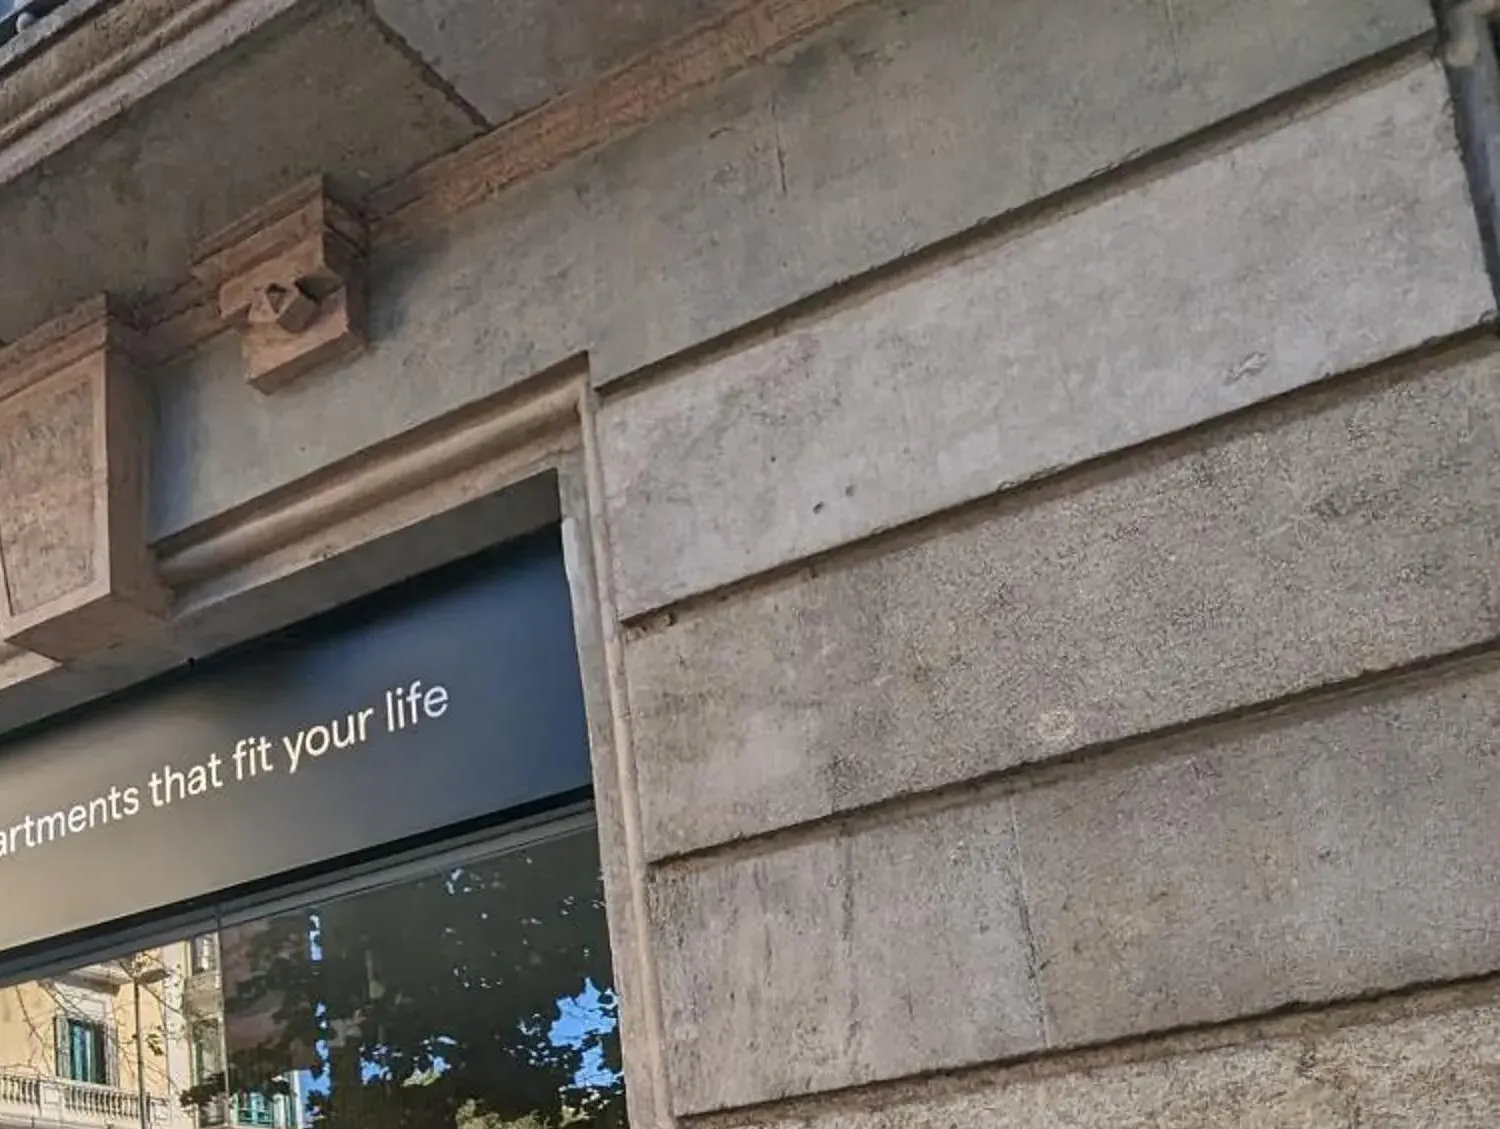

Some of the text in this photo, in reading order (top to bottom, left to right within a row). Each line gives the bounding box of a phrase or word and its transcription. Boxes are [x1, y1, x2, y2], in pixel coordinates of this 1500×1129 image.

[148, 752, 224, 808] that
[232, 735, 274, 781] fit
[282, 706, 374, 775] your
[385, 679, 449, 733] life
